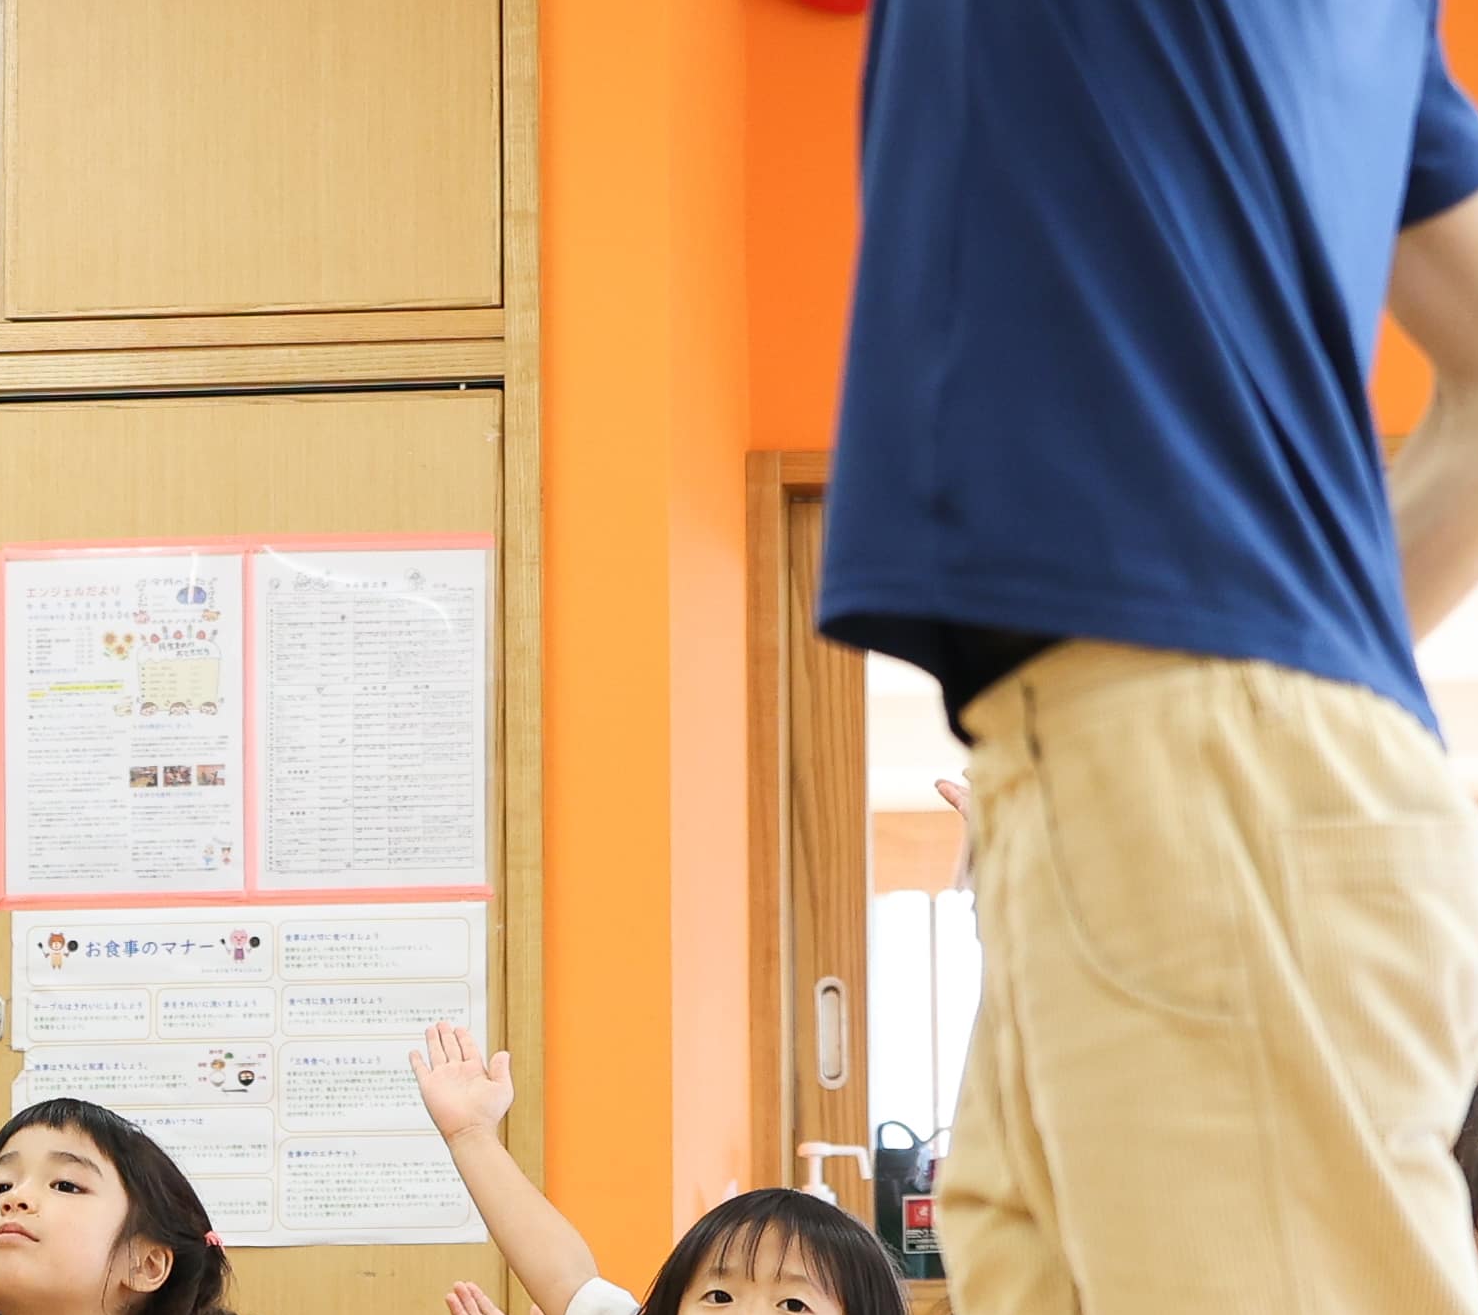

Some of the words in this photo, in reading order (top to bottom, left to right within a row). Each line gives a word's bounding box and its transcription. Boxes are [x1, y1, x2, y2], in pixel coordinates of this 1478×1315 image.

[85, 938, 216, 960] お食事のマナー
